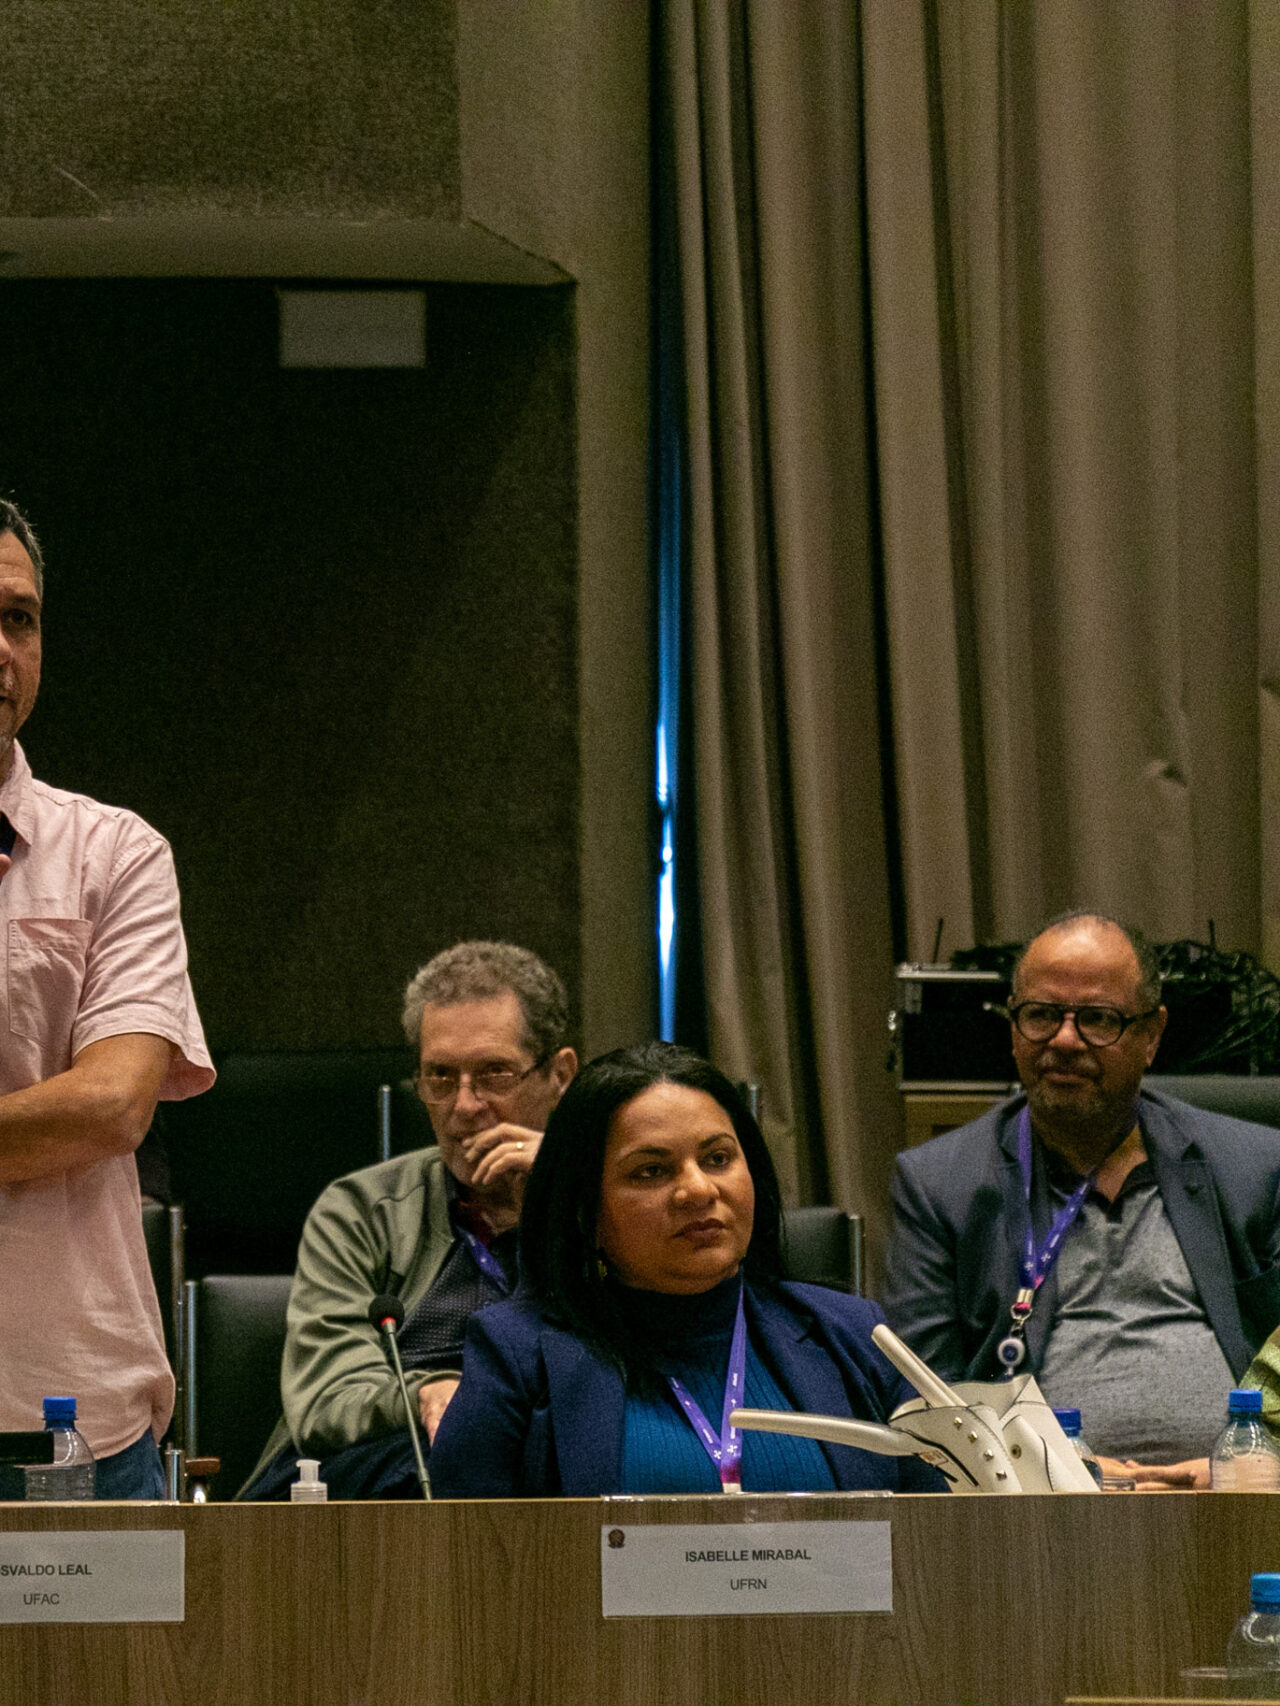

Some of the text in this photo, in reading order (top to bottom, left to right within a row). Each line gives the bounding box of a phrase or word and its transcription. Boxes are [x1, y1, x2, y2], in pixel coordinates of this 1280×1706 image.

[685, 1549, 811, 1562] ISABELLE MIRABAL
[58, 1564, 92, 1576] LEAL
[730, 1579, 767, 1591] UFRN
[23, 1593, 60, 1605] UFAC
